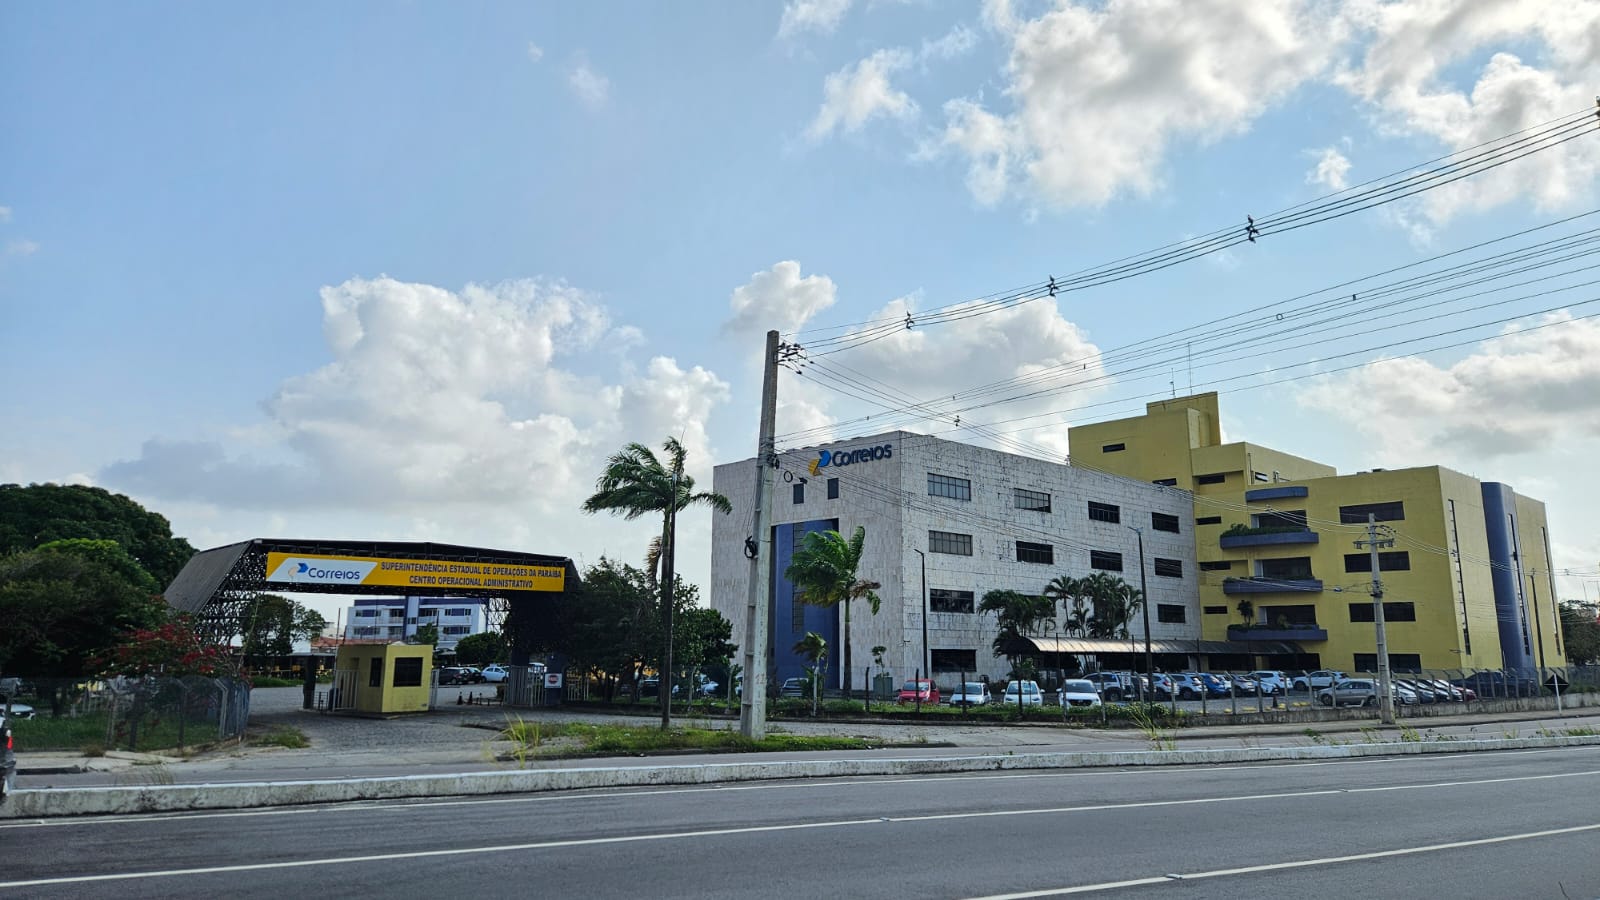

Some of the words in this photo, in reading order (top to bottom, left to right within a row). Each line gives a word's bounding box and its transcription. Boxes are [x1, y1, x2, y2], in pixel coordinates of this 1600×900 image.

[832, 444, 892, 467] Correios
[308, 567, 360, 580] Correios
[381, 561, 448, 573] SUPERINTENDÊNCIA
[449, 564, 481, 574] ESTADUAL
[483, 566, 491, 575] DE
[492, 566, 528, 577] OPERAÇÕES
[529, 568, 536, 576] DA
[409, 575, 436, 584] CENTRO
[438, 576, 481, 586] OPERACIONAL
[483, 578, 533, 588] ADMINISTRATIVO
